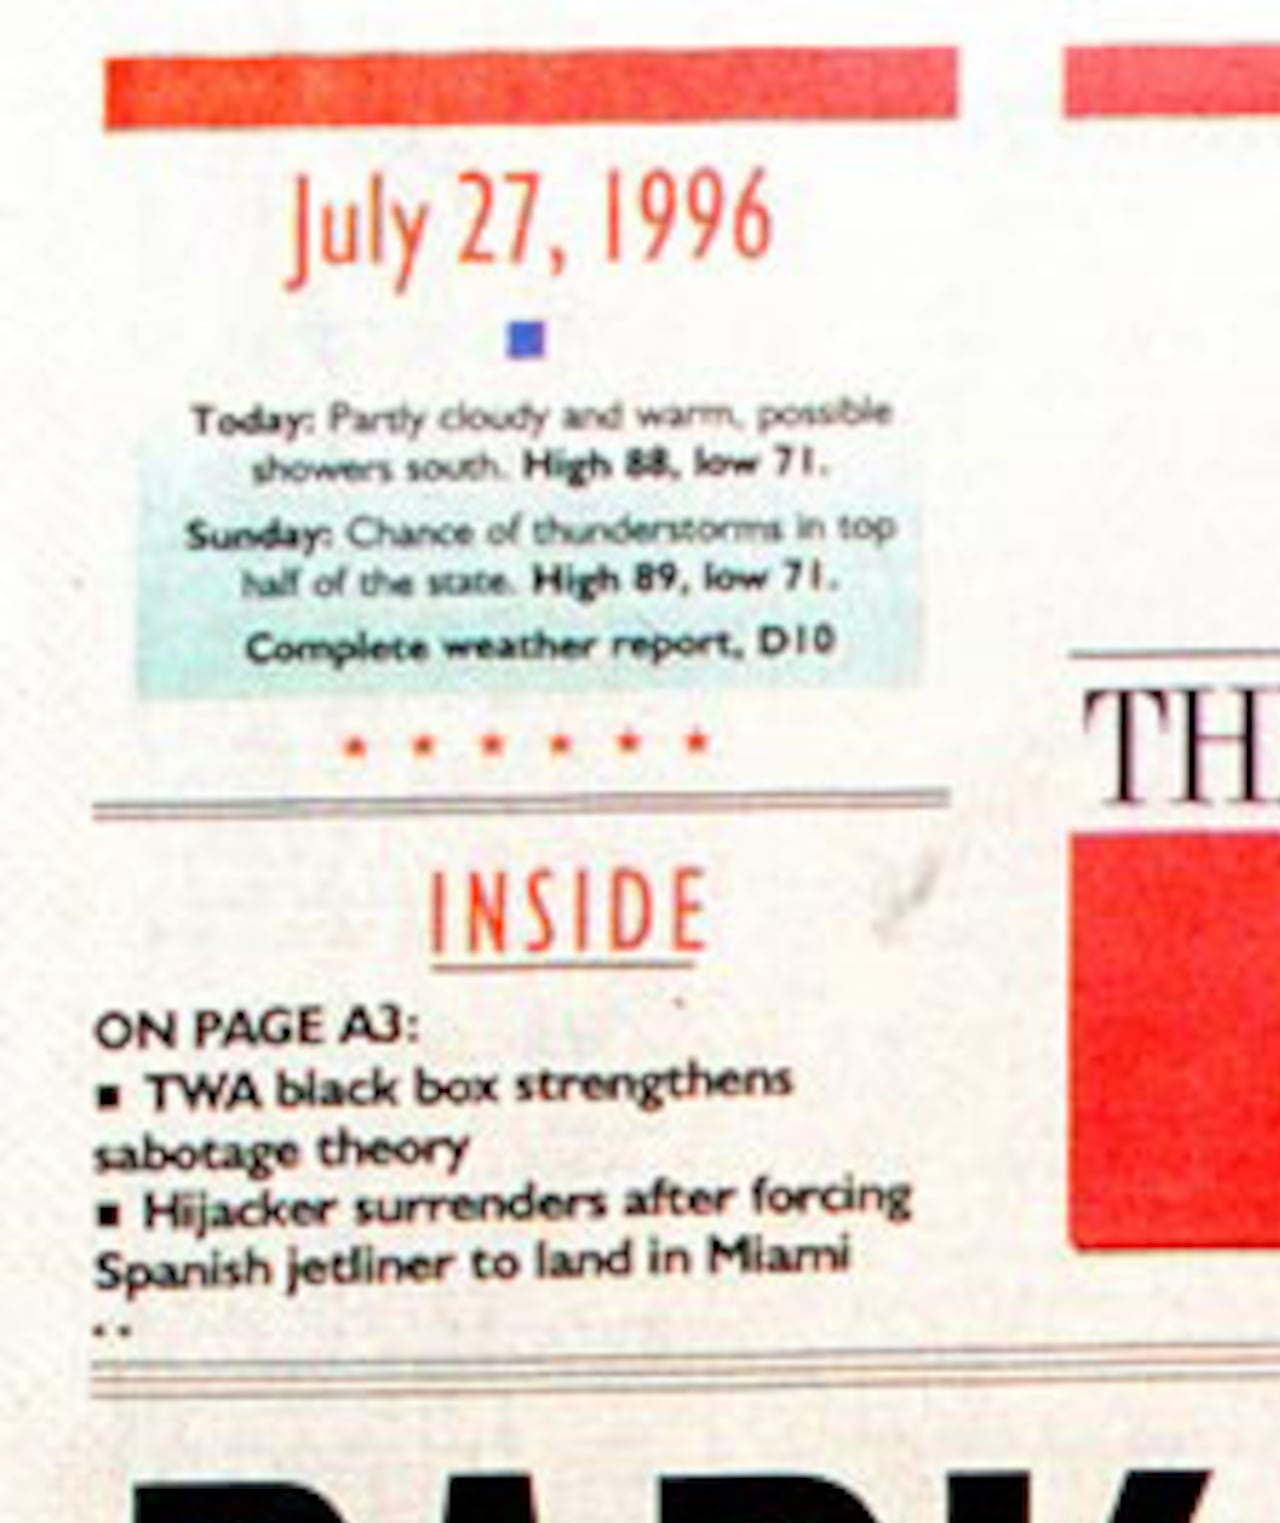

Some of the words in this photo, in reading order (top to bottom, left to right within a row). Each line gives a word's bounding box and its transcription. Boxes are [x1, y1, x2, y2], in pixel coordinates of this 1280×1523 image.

[286, 171, 428, 297] July
[459, 168, 564, 276] 27,
[608, 166, 771, 262] 1996
[191, 402, 314, 442] Today:
[329, 400, 425, 440] Partly
[438, 402, 549, 438] cloudy
[563, 404, 623, 431] and
[637, 405, 743, 429] warm,
[758, 397, 891, 433] possible
[253, 453, 392, 485] showers
[407, 454, 508, 481] south.
[523, 449, 612, 485] High
[625, 446, 680, 481] 88,
[695, 446, 759, 476] low
[776, 444, 829, 475] 71.
[246, 630, 429, 671] Complete
[443, 629, 597, 660] weather
[612, 632, 743, 665] report,
[759, 624, 835, 656] D10
[432, 866, 703, 955] INSIDE
[95, 1010, 176, 1050] ON
[195, 1006, 322, 1048] PAGE
[339, 1003, 416, 1044] A3:
[145, 1071, 262, 1112] TWA
[276, 1068, 397, 1108] black
[415, 1065, 498, 1106] box
[516, 1058, 793, 1114] strengthens
[94, 1131, 299, 1182] sabotage
[317, 1124, 470, 1177] theory
[144, 1187, 338, 1240] Hijacker
[355, 1180, 607, 1226] surrenders
[624, 1175, 736, 1217] after
[752, 1172, 911, 1226] forcing
[96, 1248, 272, 1302] Spanish
[287, 1243, 455, 1296] jetliner
[471, 1248, 520, 1280] to
[536, 1238, 632, 1279] land
[649, 1238, 691, 1274] in
[708, 1232, 849, 1275] Miami
